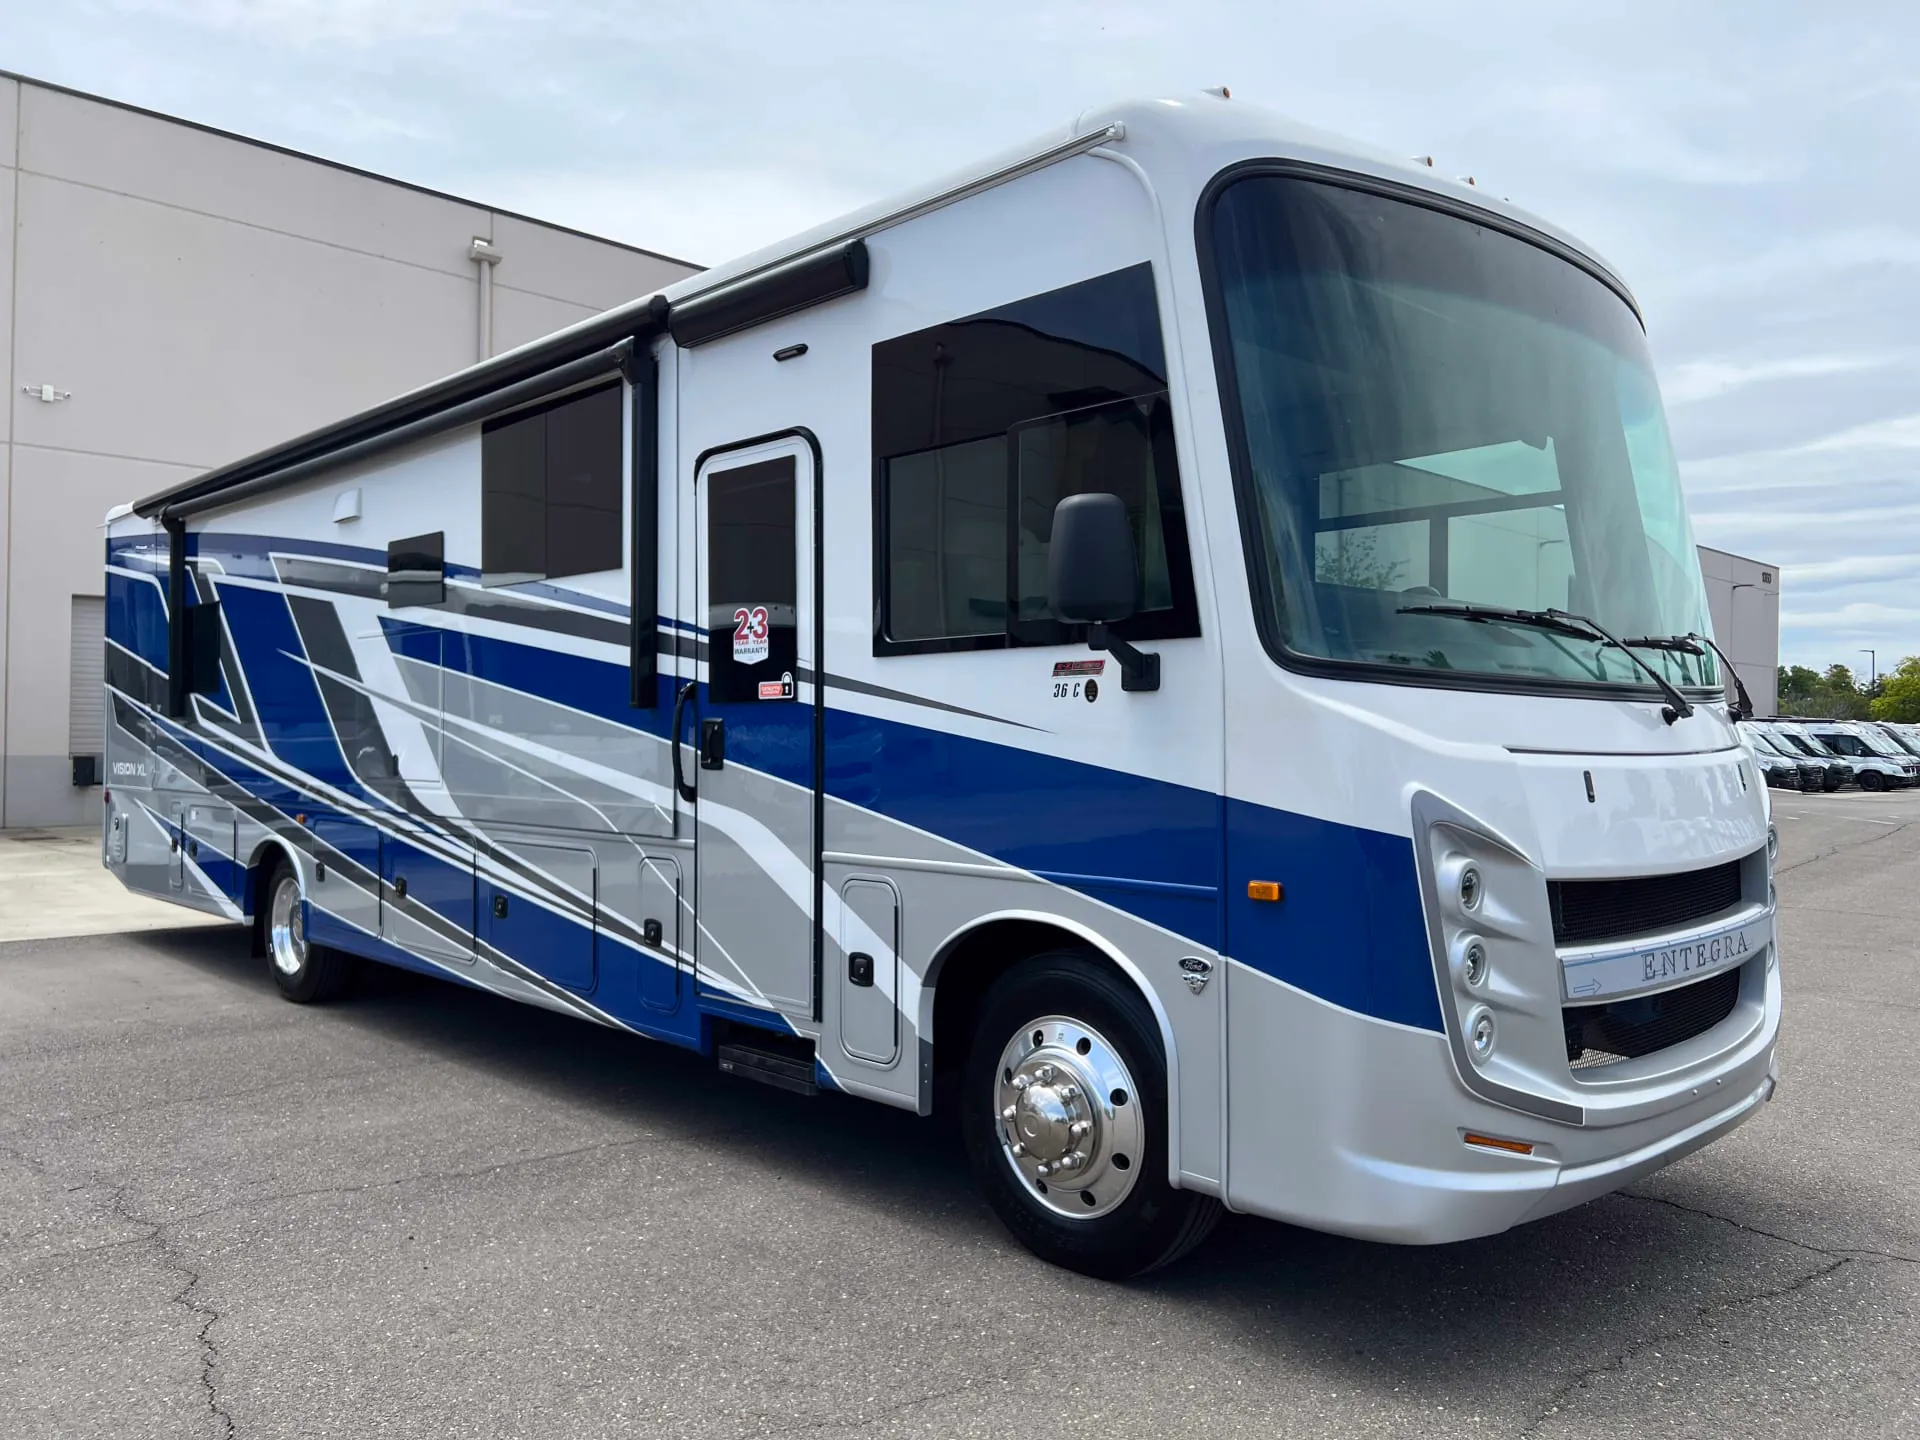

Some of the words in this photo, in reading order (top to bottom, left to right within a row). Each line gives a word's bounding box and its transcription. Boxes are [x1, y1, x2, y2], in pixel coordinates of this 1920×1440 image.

[734, 646, 768, 655] WARRANTY
[1053, 683, 1068, 698] 36
[1073, 682, 1080, 698] C
[112, 761, 136, 775] VISION
[137, 763, 147, 777] XL
[1641, 931, 1748, 981] ENTEGRA
[1183, 959, 1205, 971] Ford
